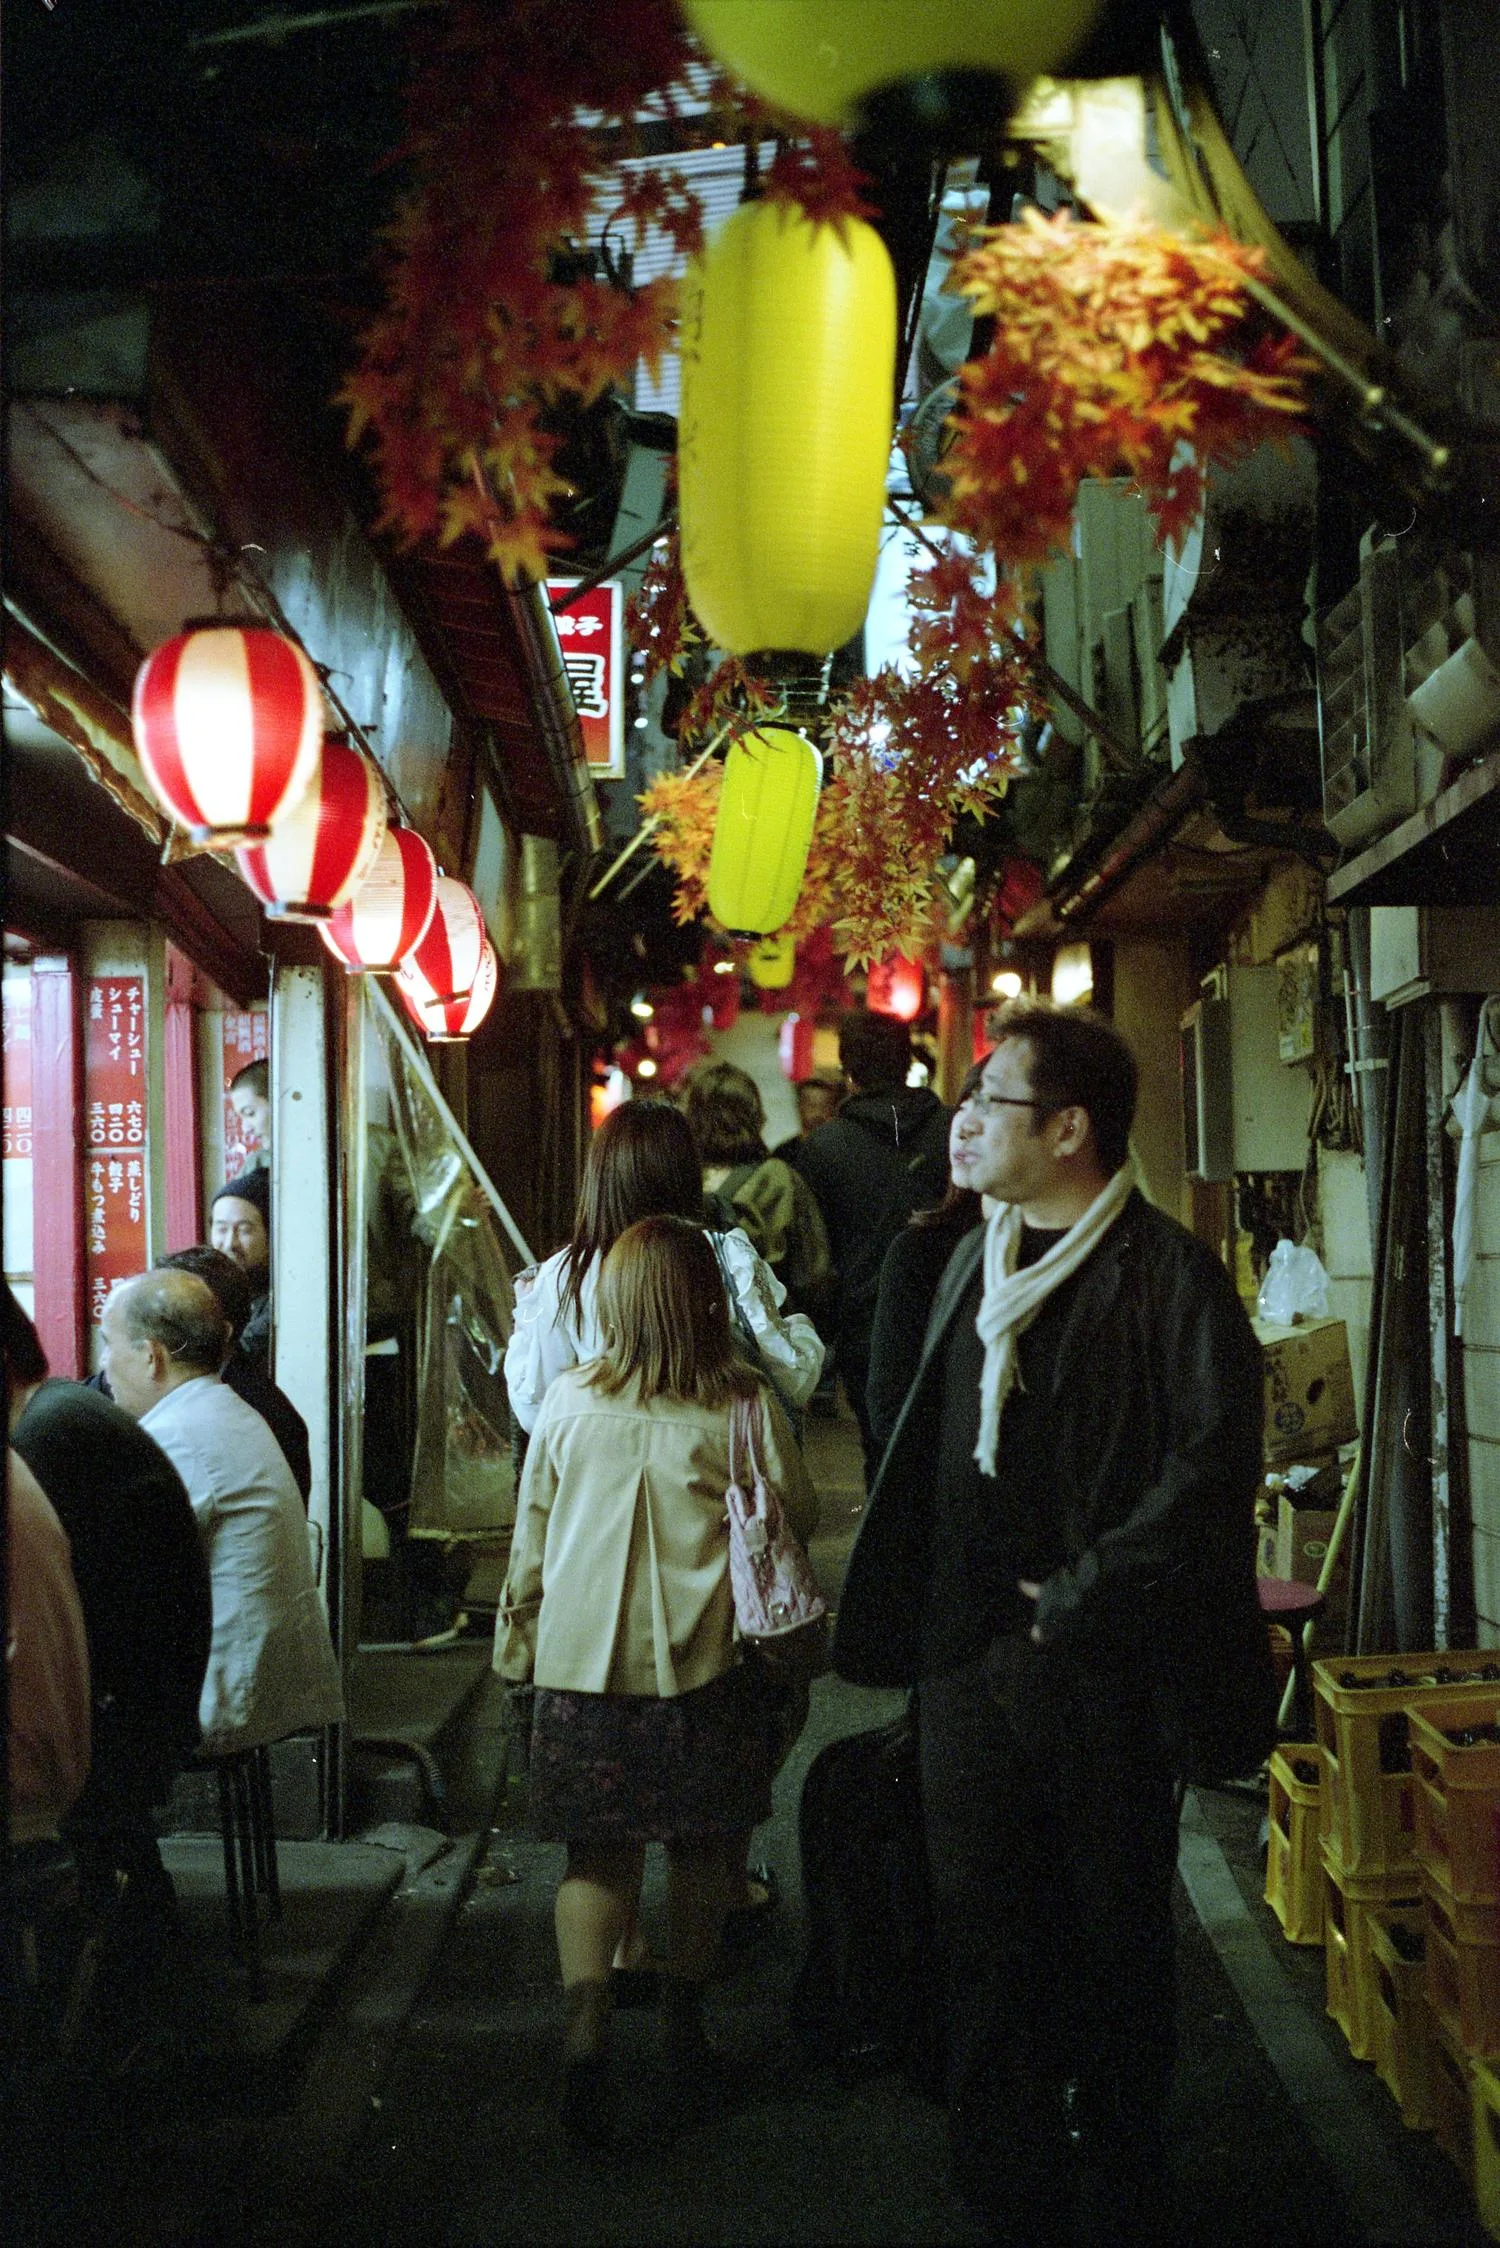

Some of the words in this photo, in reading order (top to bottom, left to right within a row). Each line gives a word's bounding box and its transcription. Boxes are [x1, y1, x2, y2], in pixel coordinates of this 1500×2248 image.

[108, 986, 123, 1061] シューマイ
[126, 986, 142, 1076] チャーシュー
[90, 1101, 106, 1143] 三六〇
[108, 1102, 124, 1143] 四二〇
[126, 1100, 142, 1143] 六七〇
[108, 1160, 124, 1194] 餃子
[91, 1161, 107, 1255] 牛もつ煮込み
